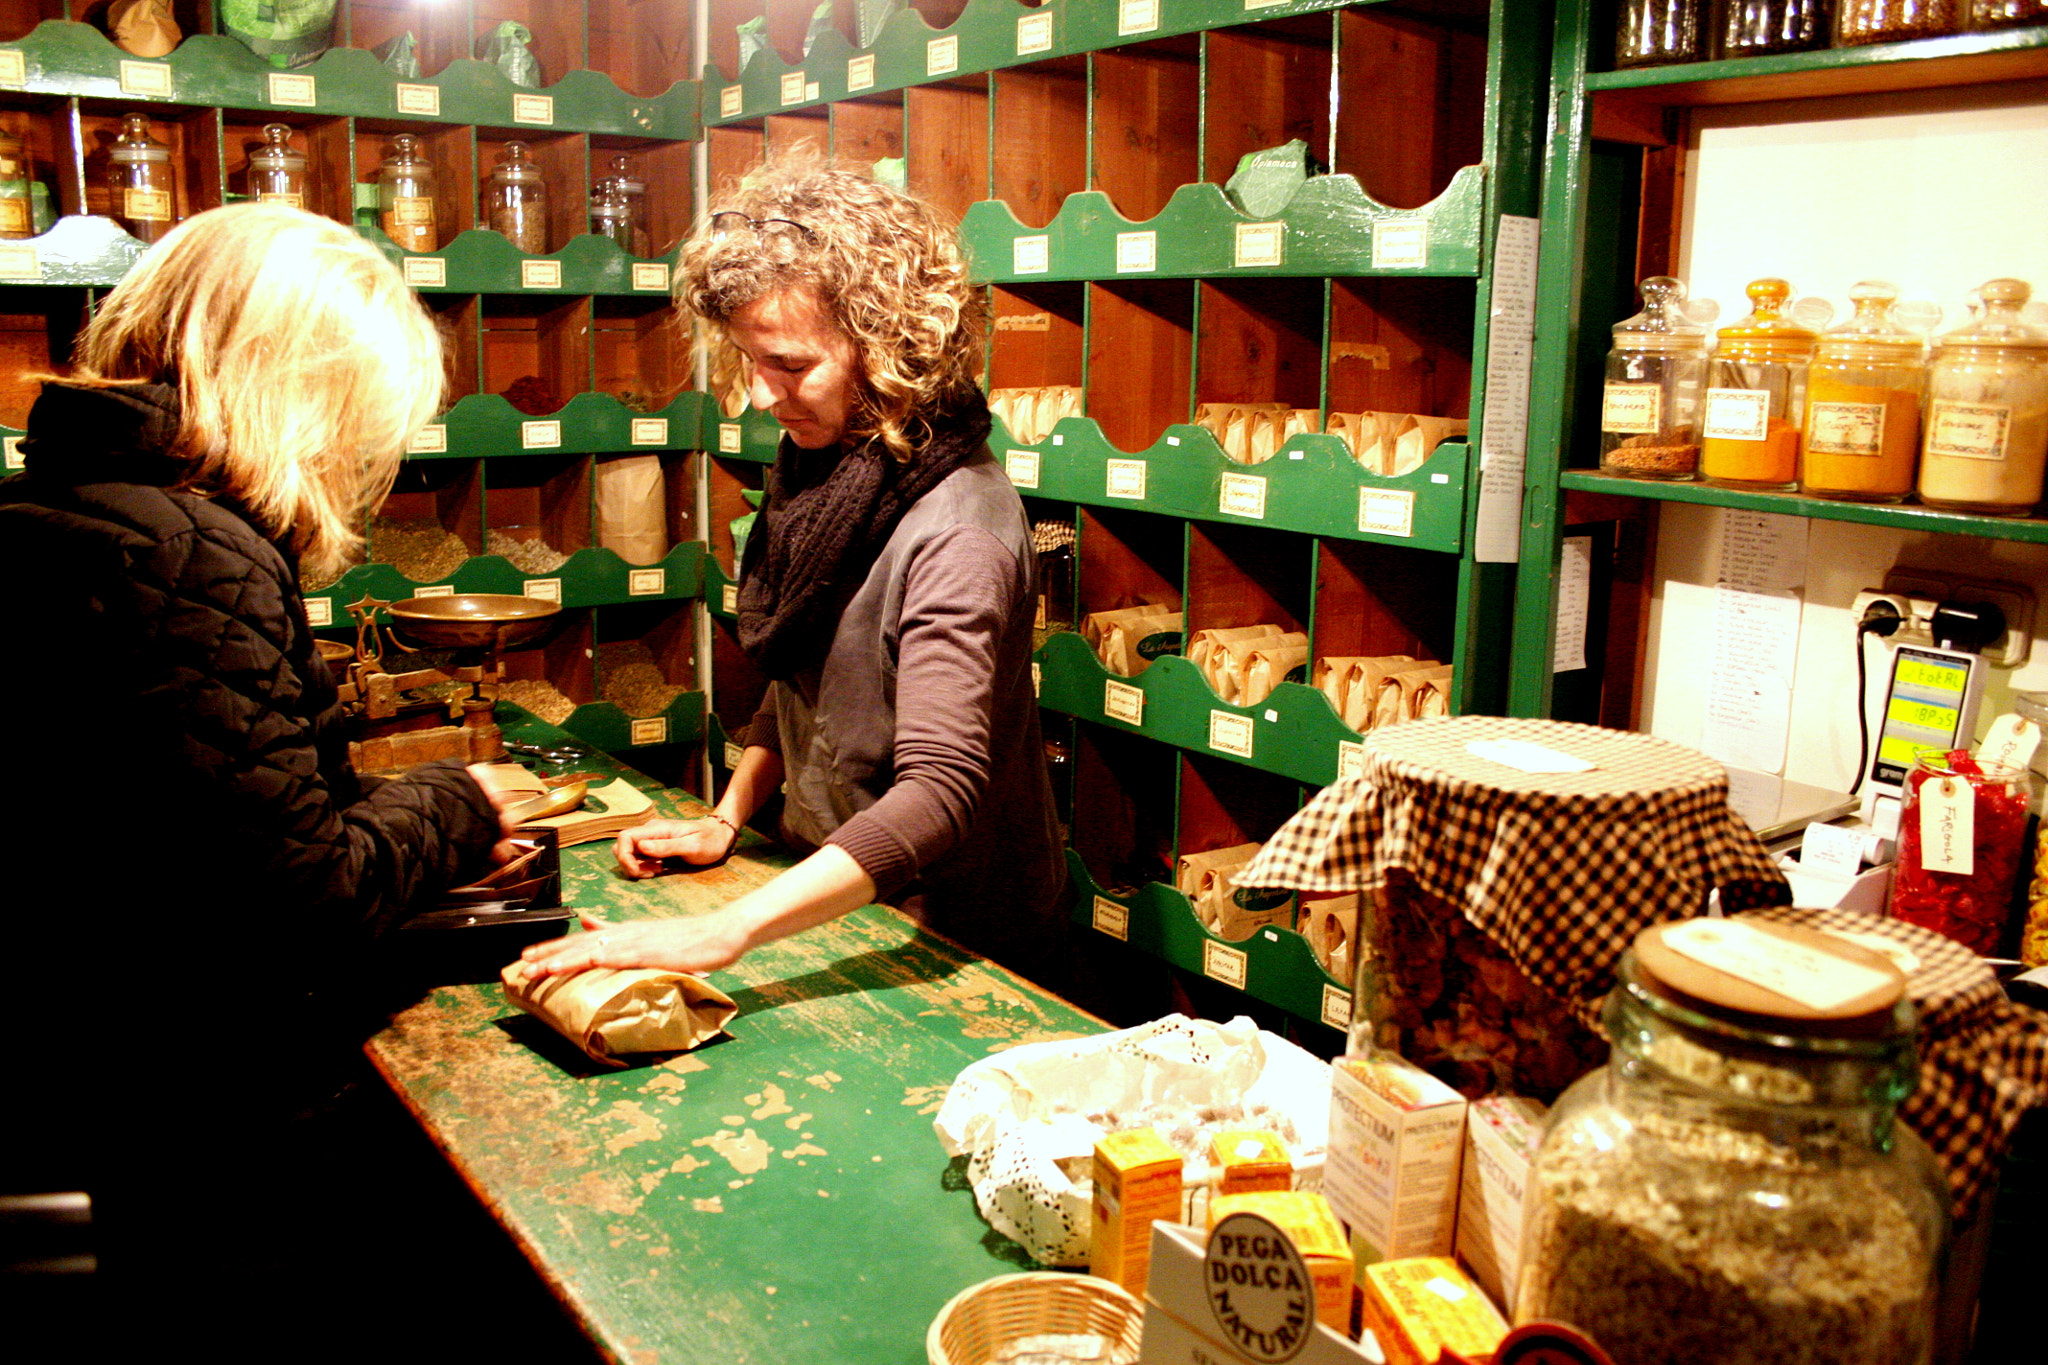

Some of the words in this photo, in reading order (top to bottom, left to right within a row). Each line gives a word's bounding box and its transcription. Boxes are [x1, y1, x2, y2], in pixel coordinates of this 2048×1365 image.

[1219, 1234, 1288, 1261] PEGA
[1211, 1261, 1302, 1292] DOLÇA
[1214, 1289, 1306, 1356] NATURAL
